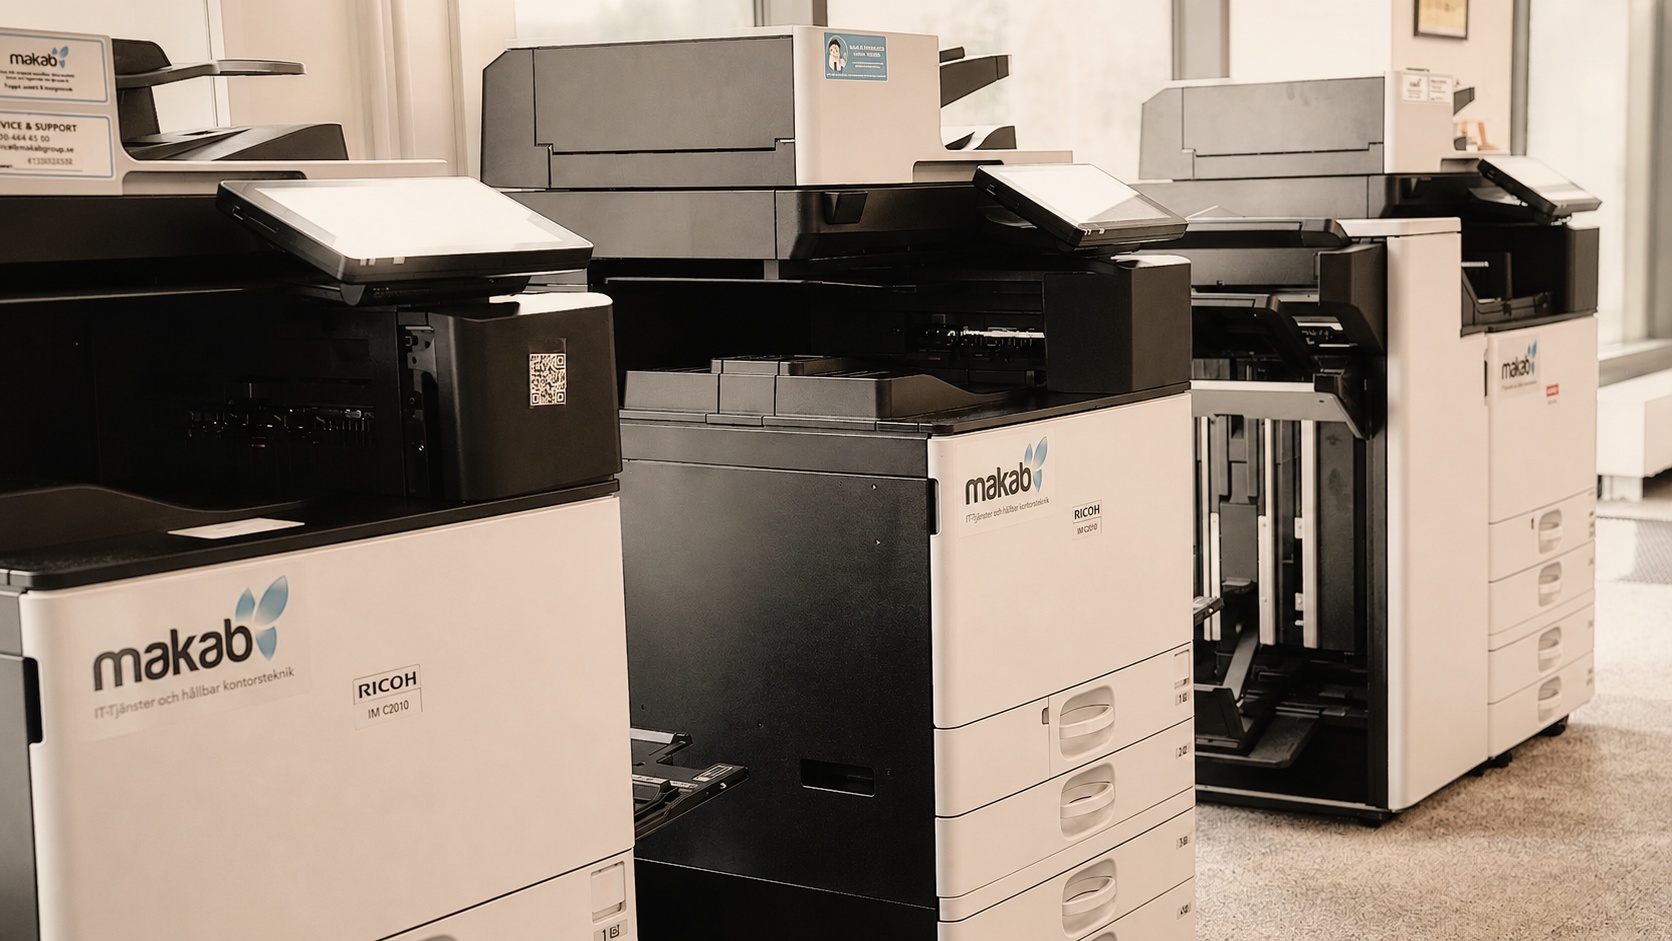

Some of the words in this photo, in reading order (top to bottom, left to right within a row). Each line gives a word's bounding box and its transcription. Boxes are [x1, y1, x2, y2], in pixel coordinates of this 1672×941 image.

[9, 53, 57, 67] makab
[35, 123, 77, 133] SUPPORT
[965, 462, 1031, 505] makab
[1074, 504, 1100, 520] RICOH
[93, 618, 254, 692] makab
[94, 697, 156, 719] IT-Tjänster
[157, 691, 180, 707] och
[182, 684, 221, 702] hållbar
[223, 666, 296, 693] kontorsteknik
[358, 671, 417, 699] RICOH
[368, 707, 381, 719] IM
[383, 699, 410, 716] C2010
